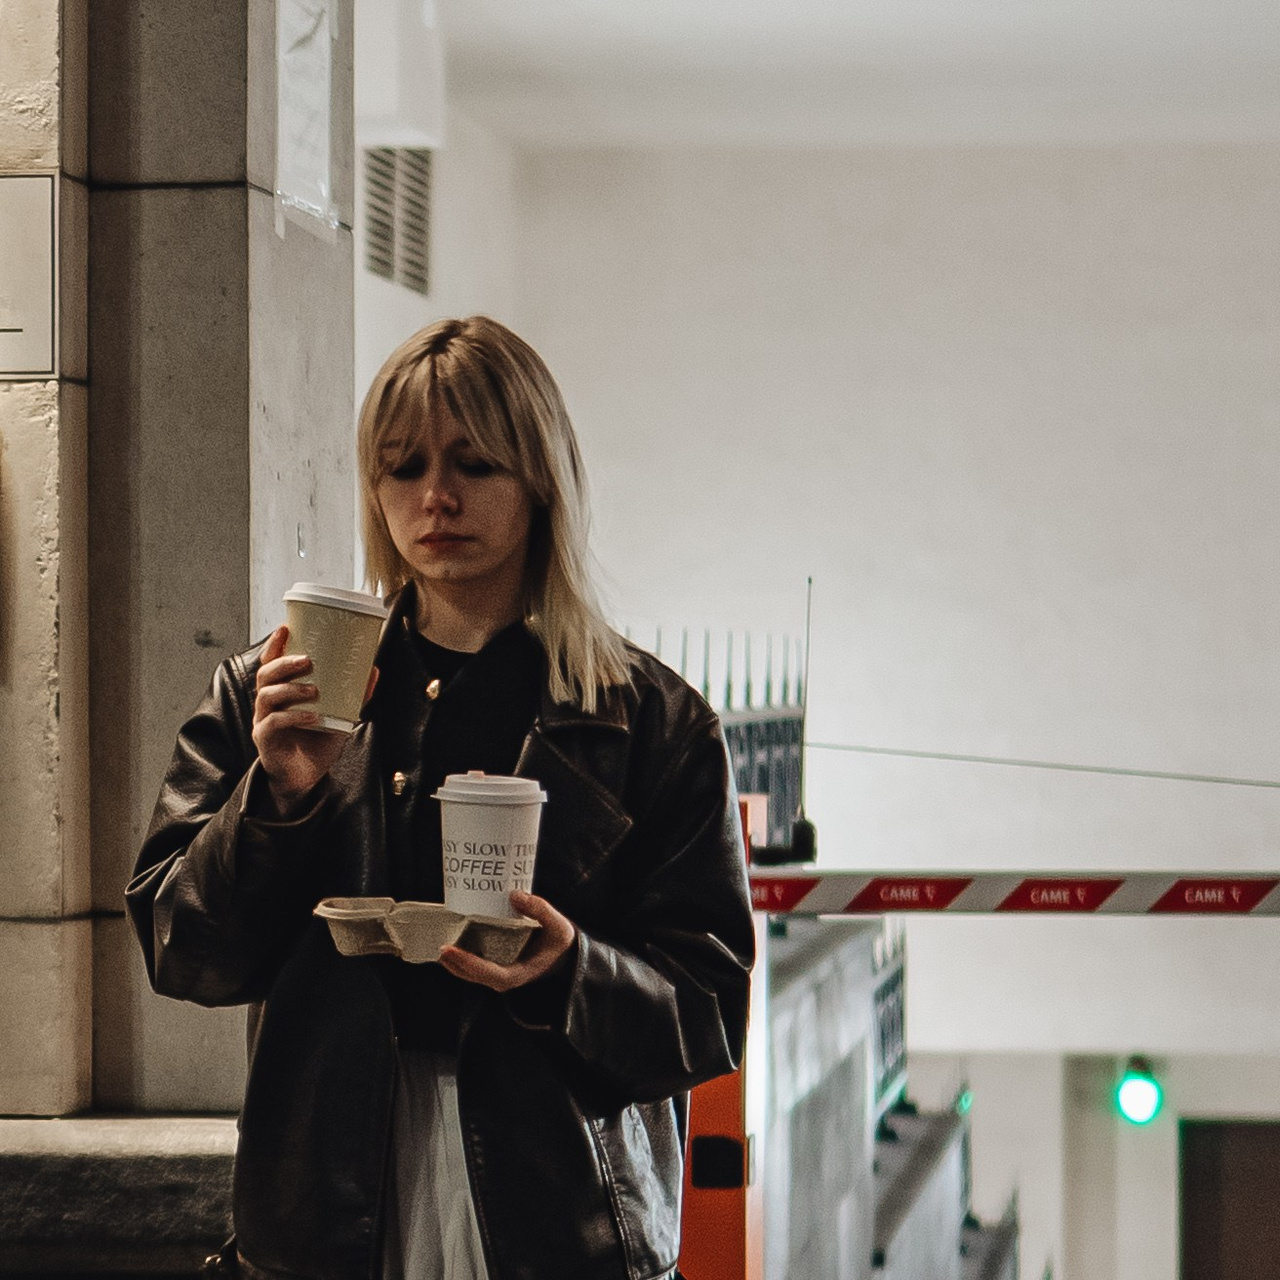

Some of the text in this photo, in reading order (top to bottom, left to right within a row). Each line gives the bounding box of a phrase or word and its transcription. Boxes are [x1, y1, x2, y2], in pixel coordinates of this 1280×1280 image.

[463, 841, 508, 857] SLOW
[462, 877, 506, 893] SLOW
[879, 885, 920, 902] CAME
[1030, 887, 1070, 904] CAME
[1184, 887, 1225, 904] CAME
